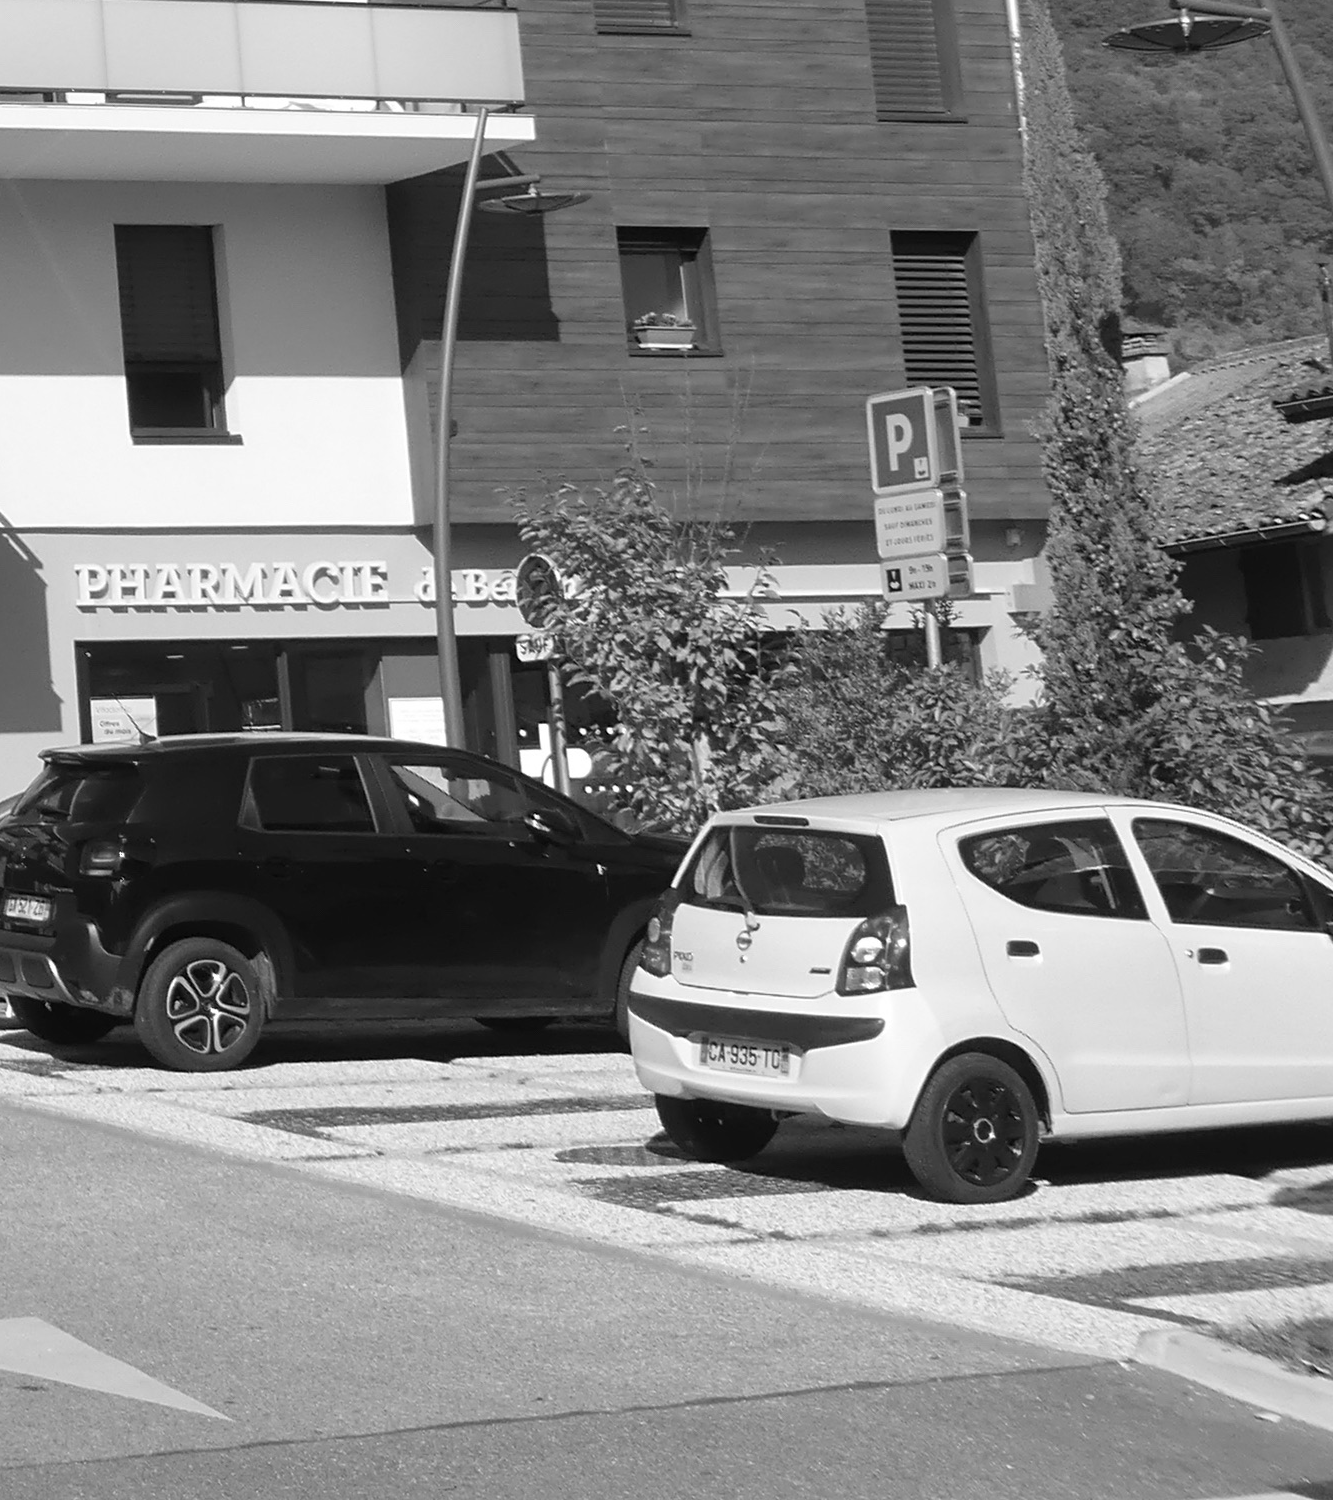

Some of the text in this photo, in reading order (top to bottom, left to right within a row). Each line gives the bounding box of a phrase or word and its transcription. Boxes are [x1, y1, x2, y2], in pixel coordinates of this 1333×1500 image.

[885, 412, 914, 472] P
[899, 517, 933, 529] DIMANCHES
[74, 561, 388, 604] PHARMACIE
